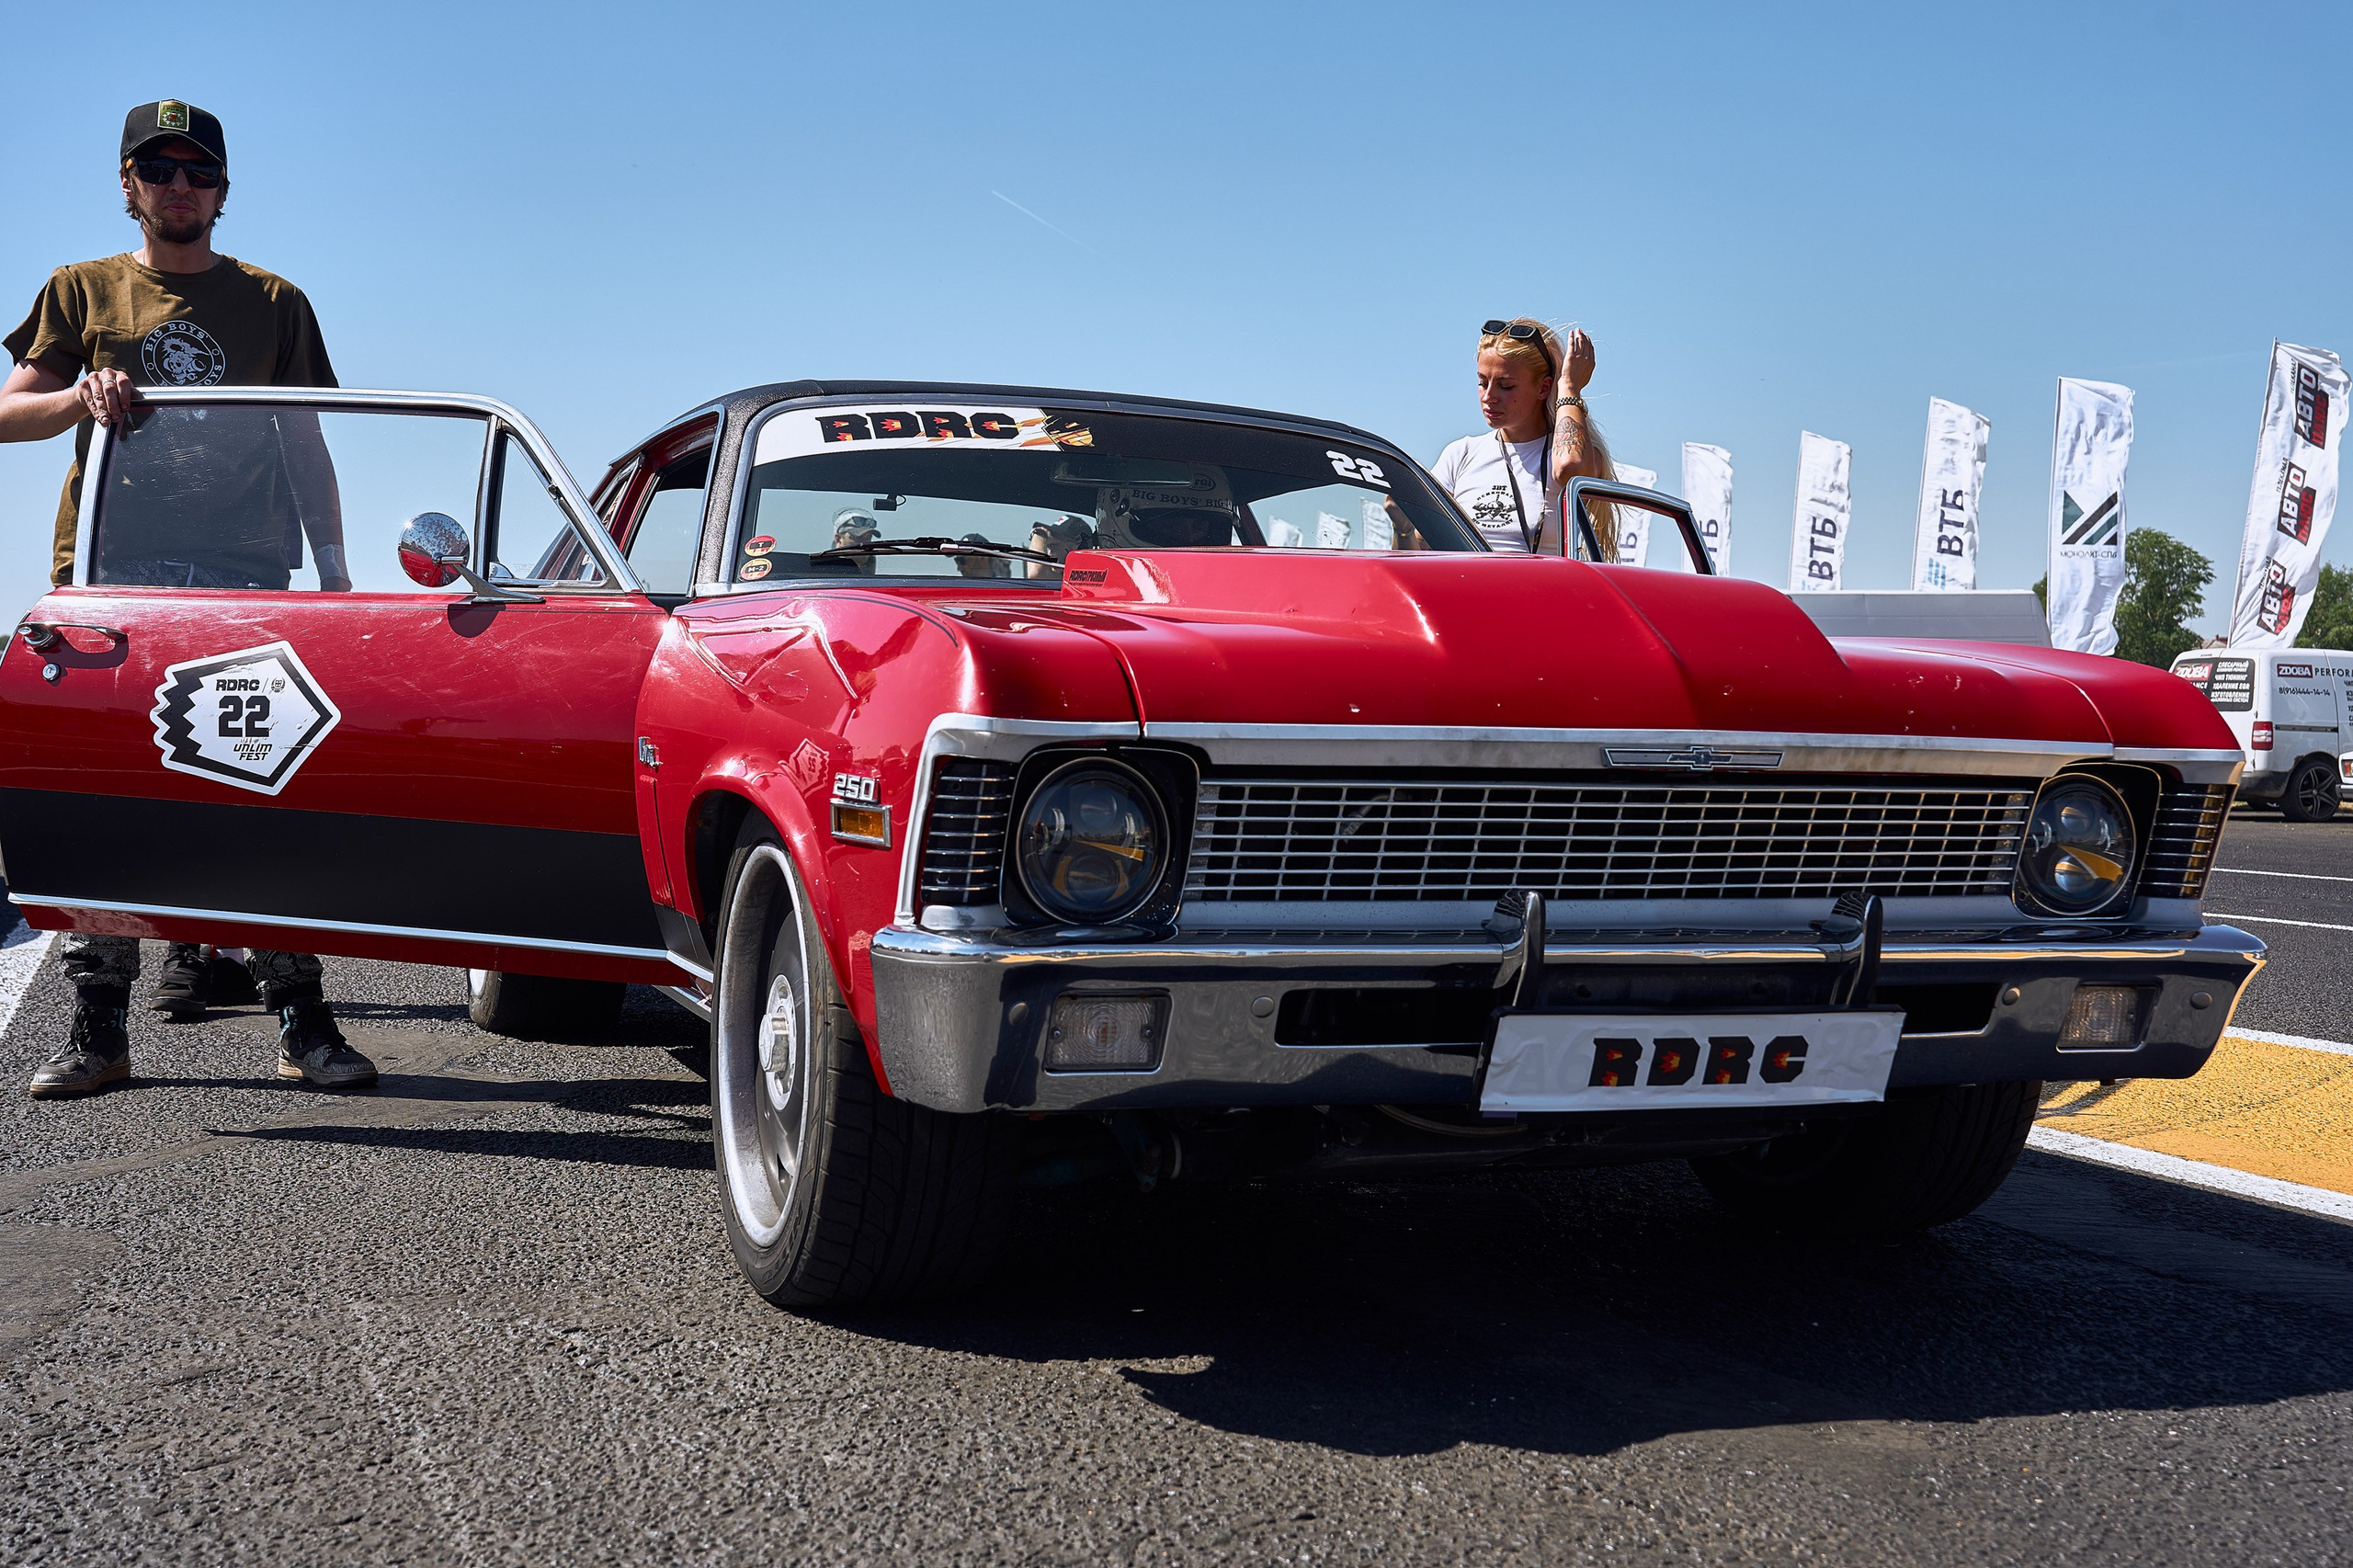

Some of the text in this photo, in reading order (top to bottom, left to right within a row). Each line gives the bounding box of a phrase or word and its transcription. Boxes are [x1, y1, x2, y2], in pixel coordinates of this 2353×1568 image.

[145, 323, 209, 352] BIG BOYS'
[2297, 368, 2316, 439] АВТО
[2312, 394, 2326, 446] ПЛЮС
[815, 411, 1020, 443] RDRC
[1325, 450, 1392, 488] 22
[1131, 489, 1156, 501] BIG
[2280, 467, 2304, 536] АВТО
[1937, 488, 1965, 557] ВТБ
[2298, 492, 2313, 542] ПЛЮС
[1808, 517, 1836, 581] ВТБ
[2261, 563, 2284, 632] АВТО
[215, 678, 260, 691] RDRC
[2279, 666, 2312, 676] ZDOBA
[218, 695, 270, 737] 22
[238, 753, 268, 761] FEST
[832, 772, 876, 801] 250
[1587, 1035, 1809, 1087] RDRC
